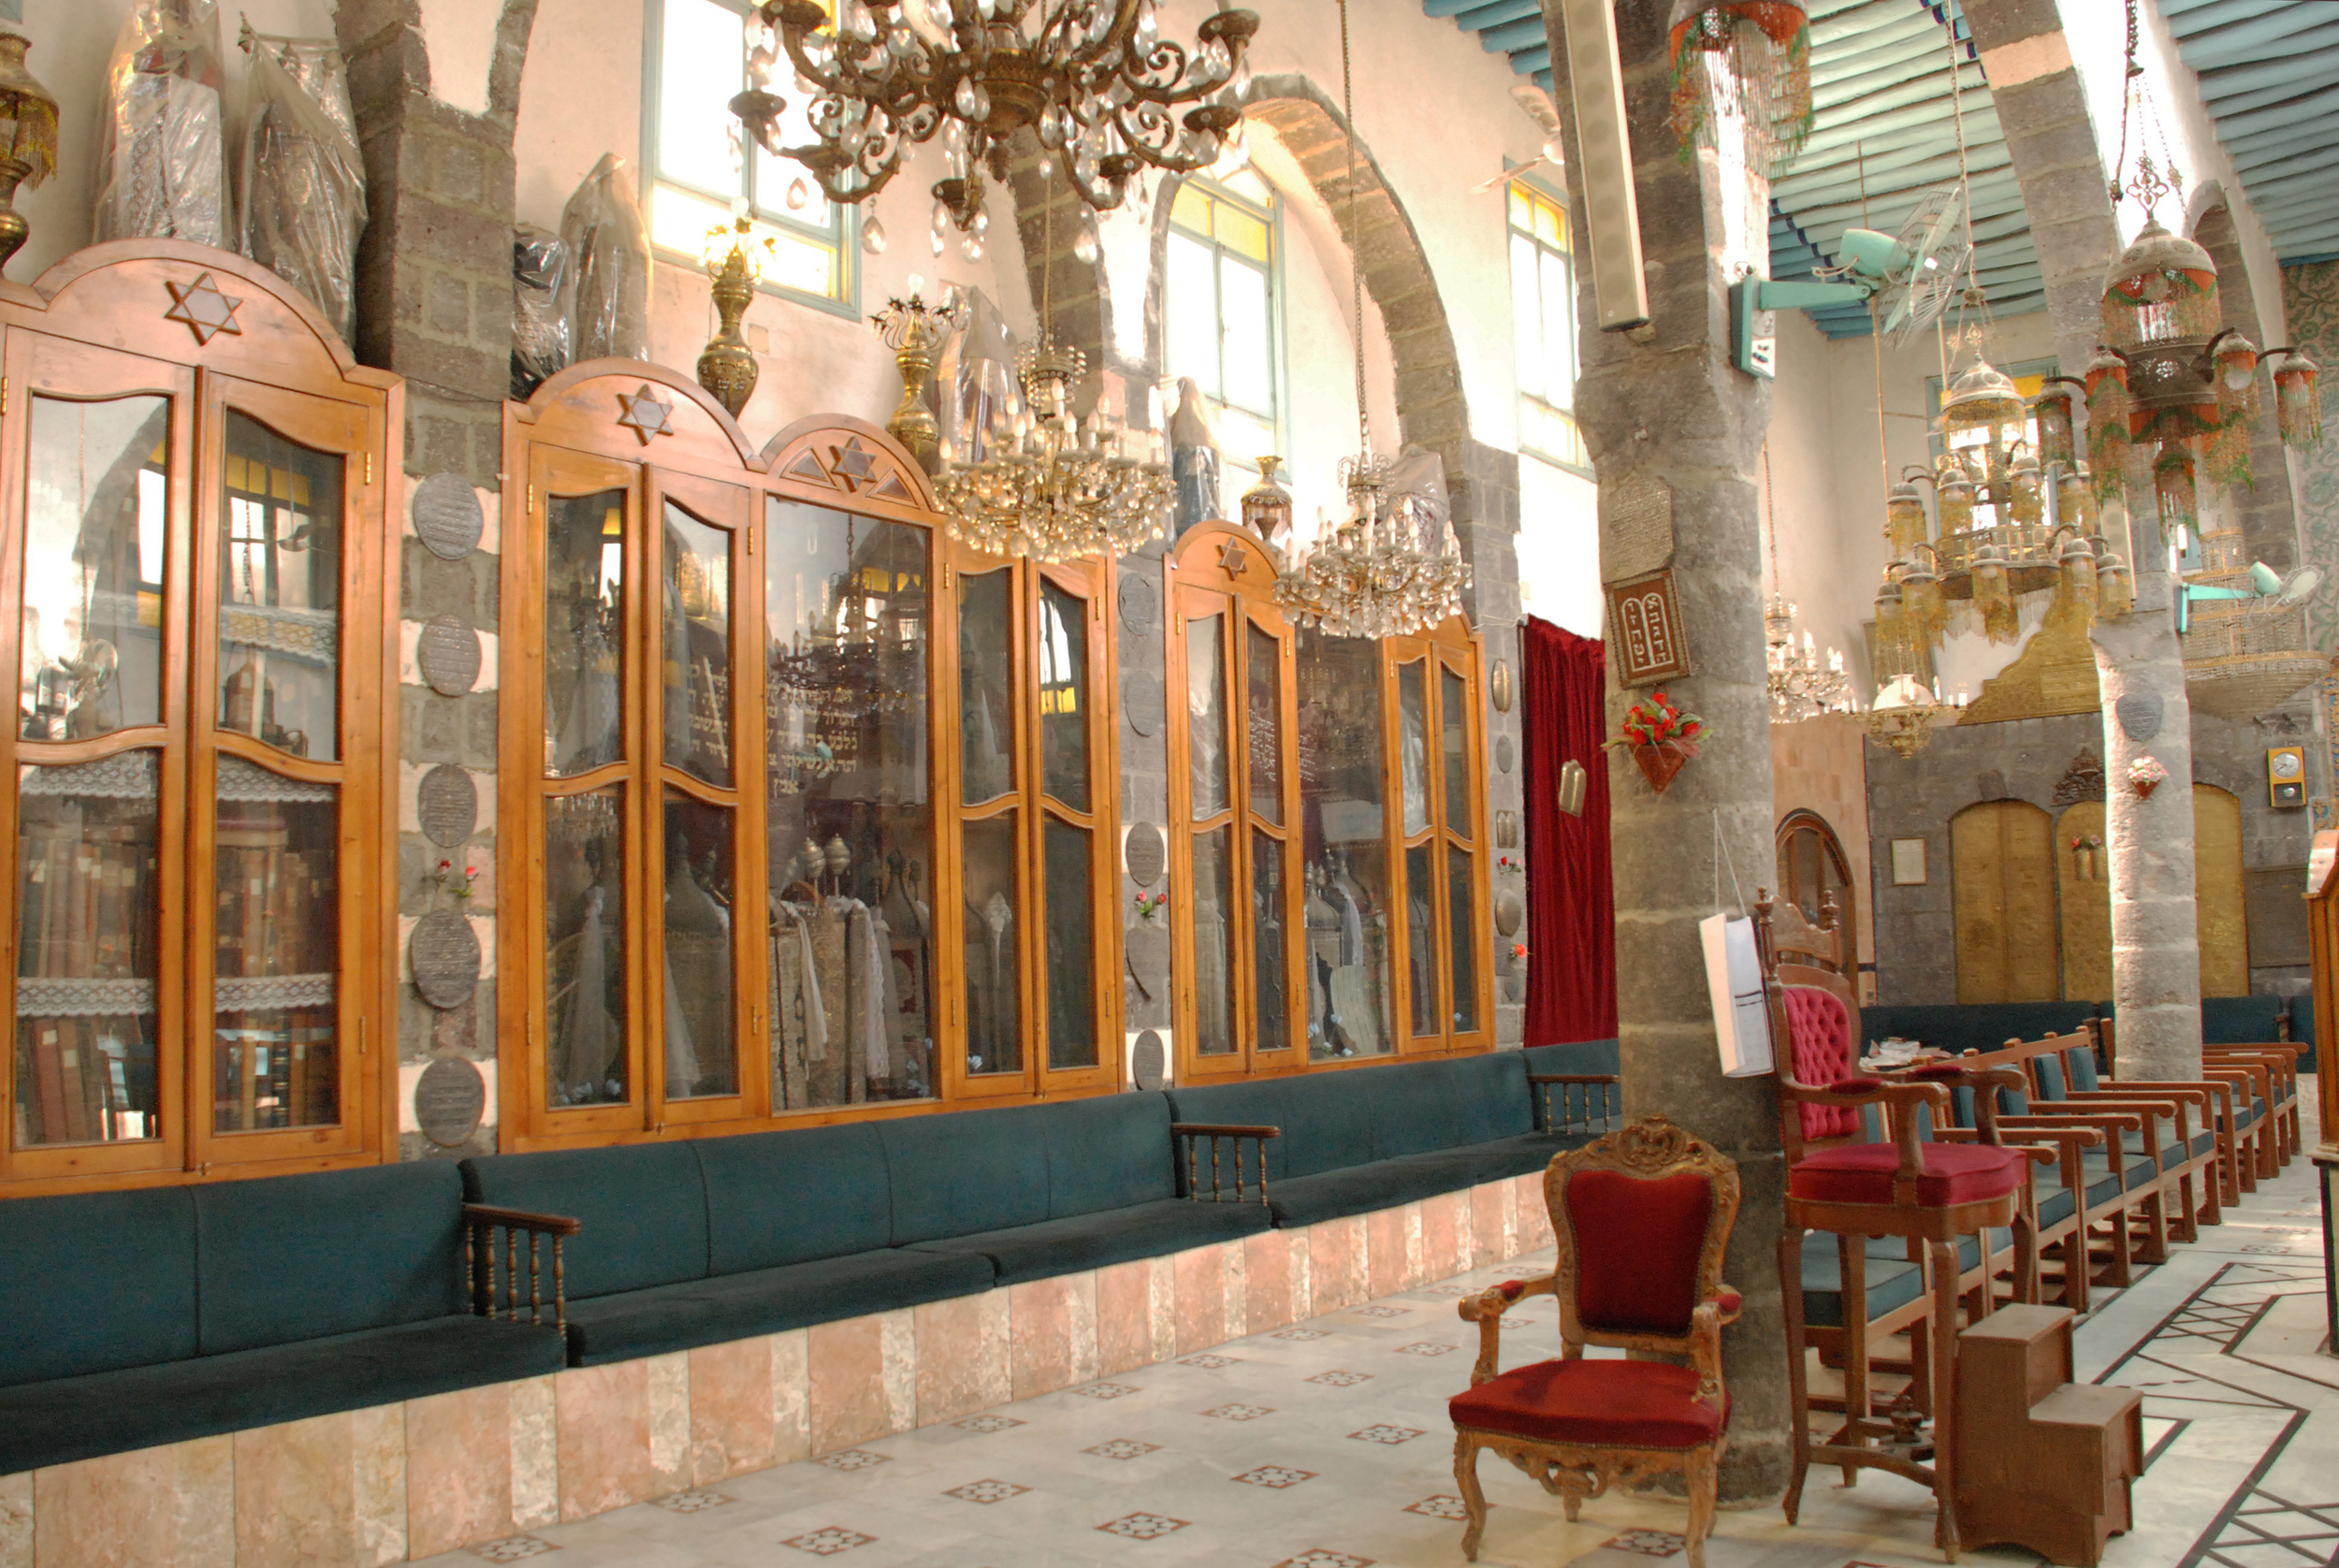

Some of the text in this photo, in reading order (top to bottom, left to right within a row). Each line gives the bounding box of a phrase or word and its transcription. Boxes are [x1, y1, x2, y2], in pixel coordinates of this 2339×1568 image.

[1647, 597, 1659, 609] א
[1649, 612, 1661, 623] ב
[1631, 630, 1642, 641] ח
[1652, 626, 1661, 637] ג
[1634, 644, 1645, 656] ט
[1654, 639, 1663, 651] ד
